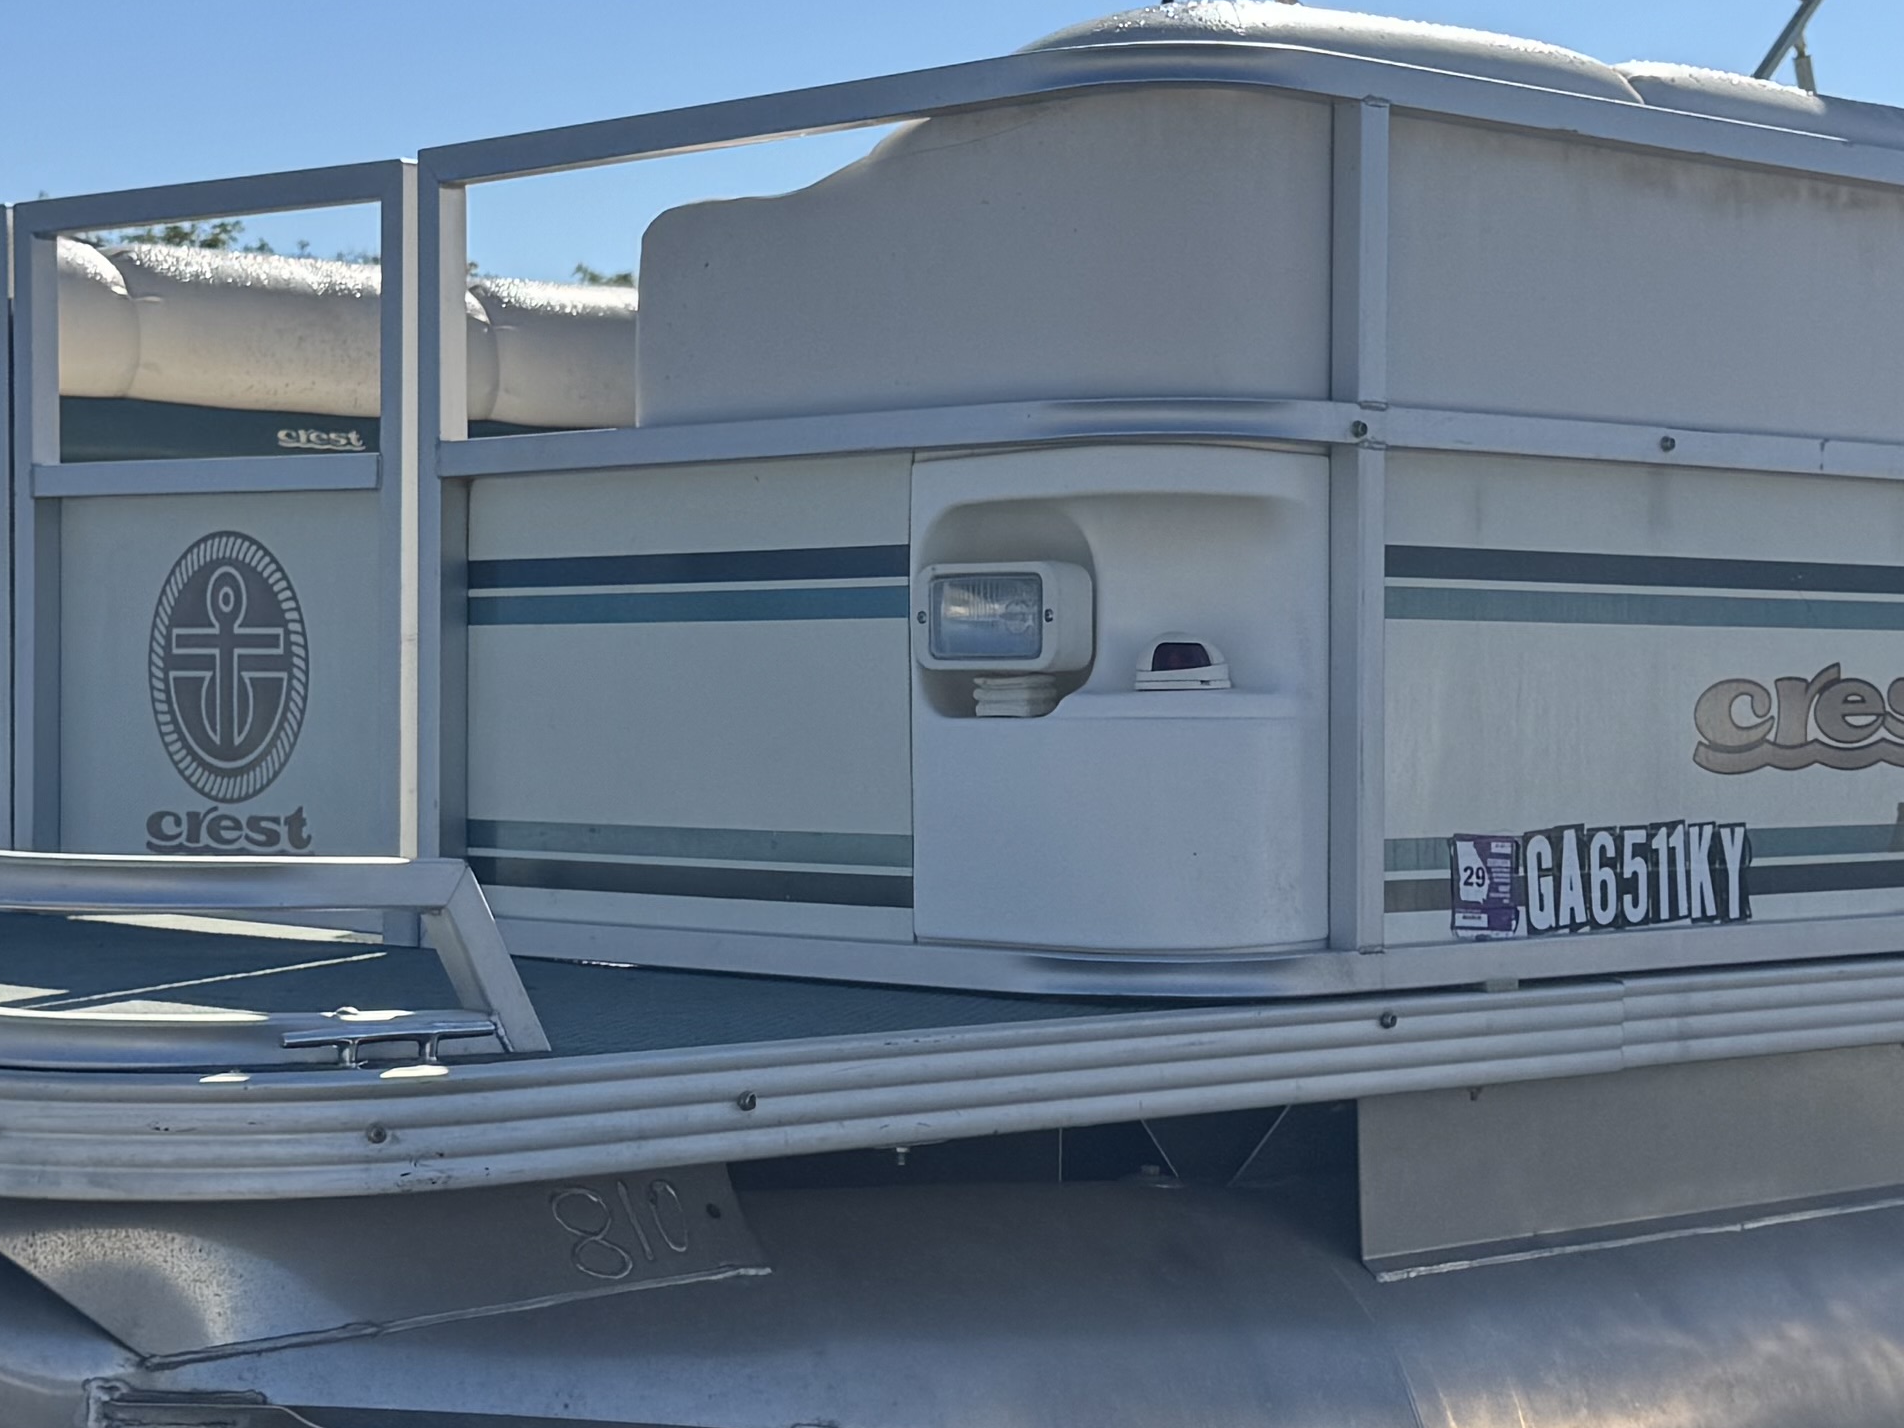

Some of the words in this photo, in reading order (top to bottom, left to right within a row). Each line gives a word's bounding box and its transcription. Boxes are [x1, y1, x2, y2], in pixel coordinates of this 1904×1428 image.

[277, 429, 363, 447] crest
[146, 806, 312, 850] crest
[1463, 865, 1486, 887] 29
